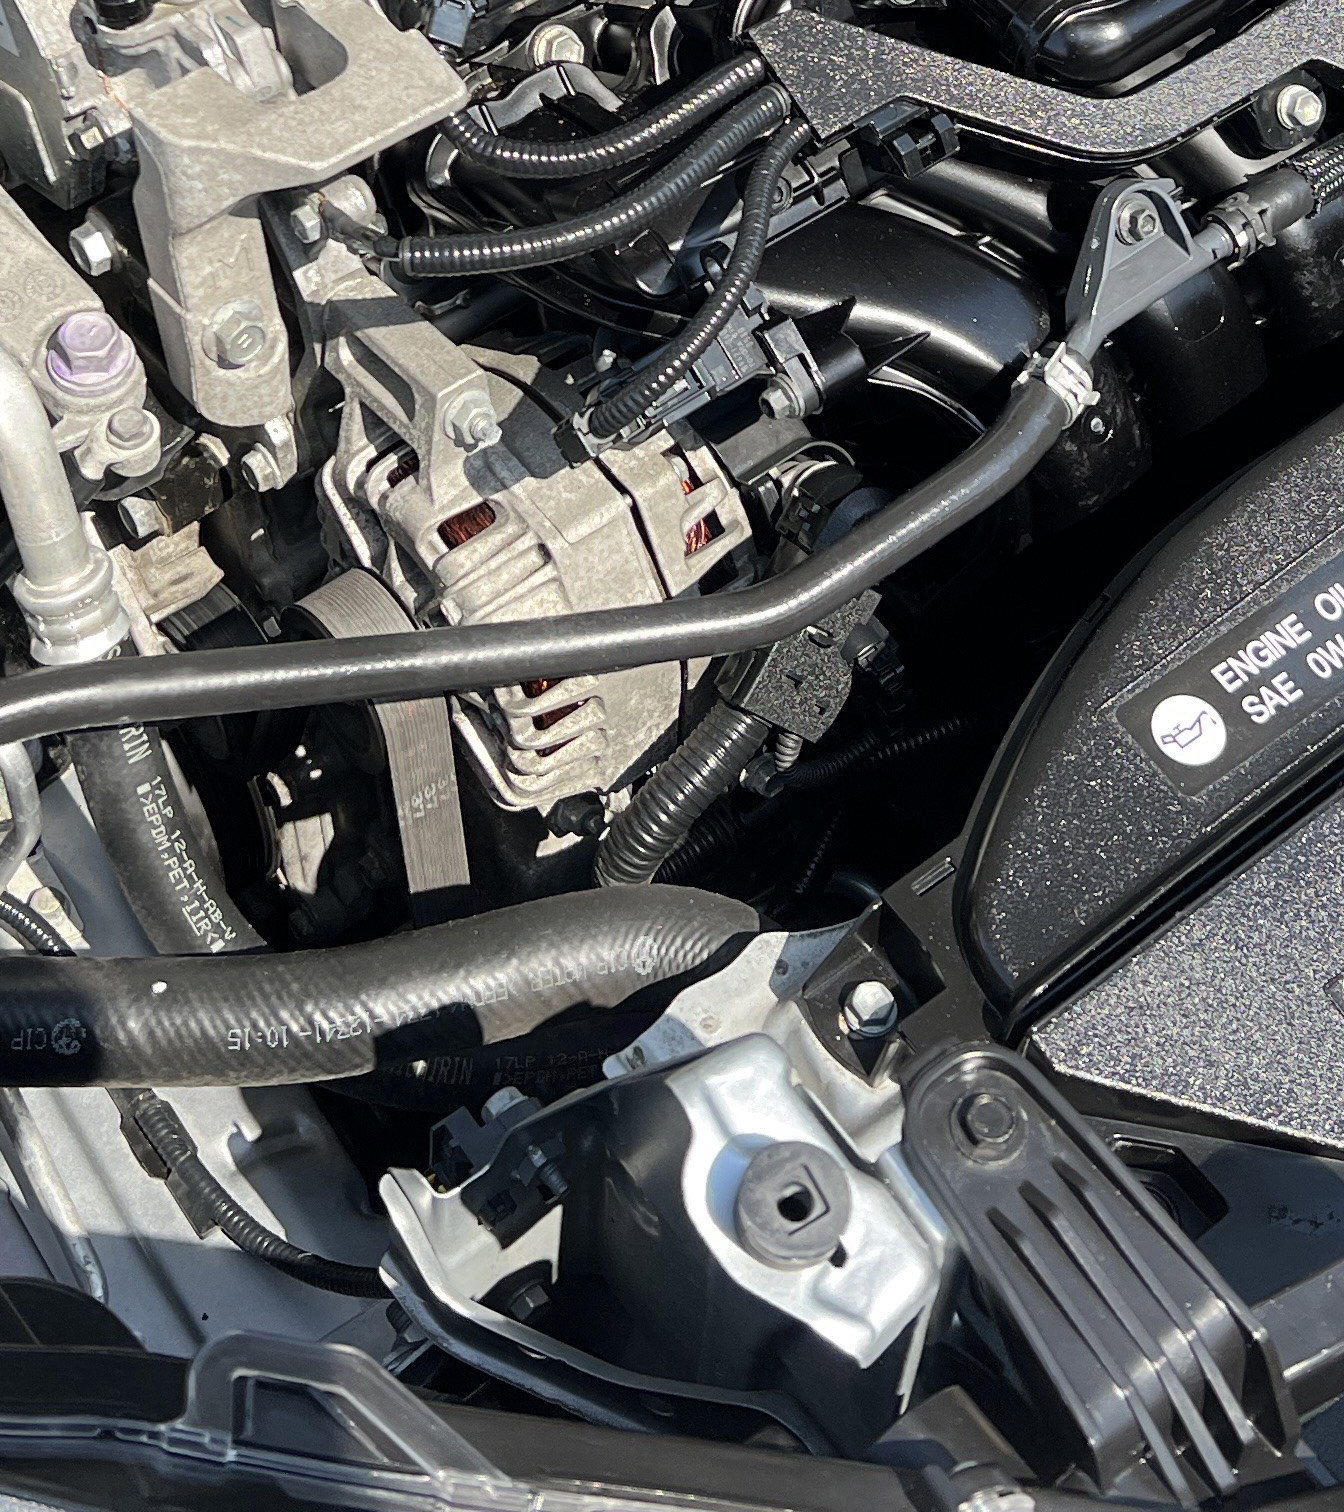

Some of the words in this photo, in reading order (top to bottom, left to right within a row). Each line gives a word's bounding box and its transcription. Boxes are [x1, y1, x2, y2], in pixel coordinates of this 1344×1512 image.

[1210, 614, 1310, 695] ENGINE
[1241, 672, 1302, 725] SAE
[149, 775, 176, 820] 17LP
